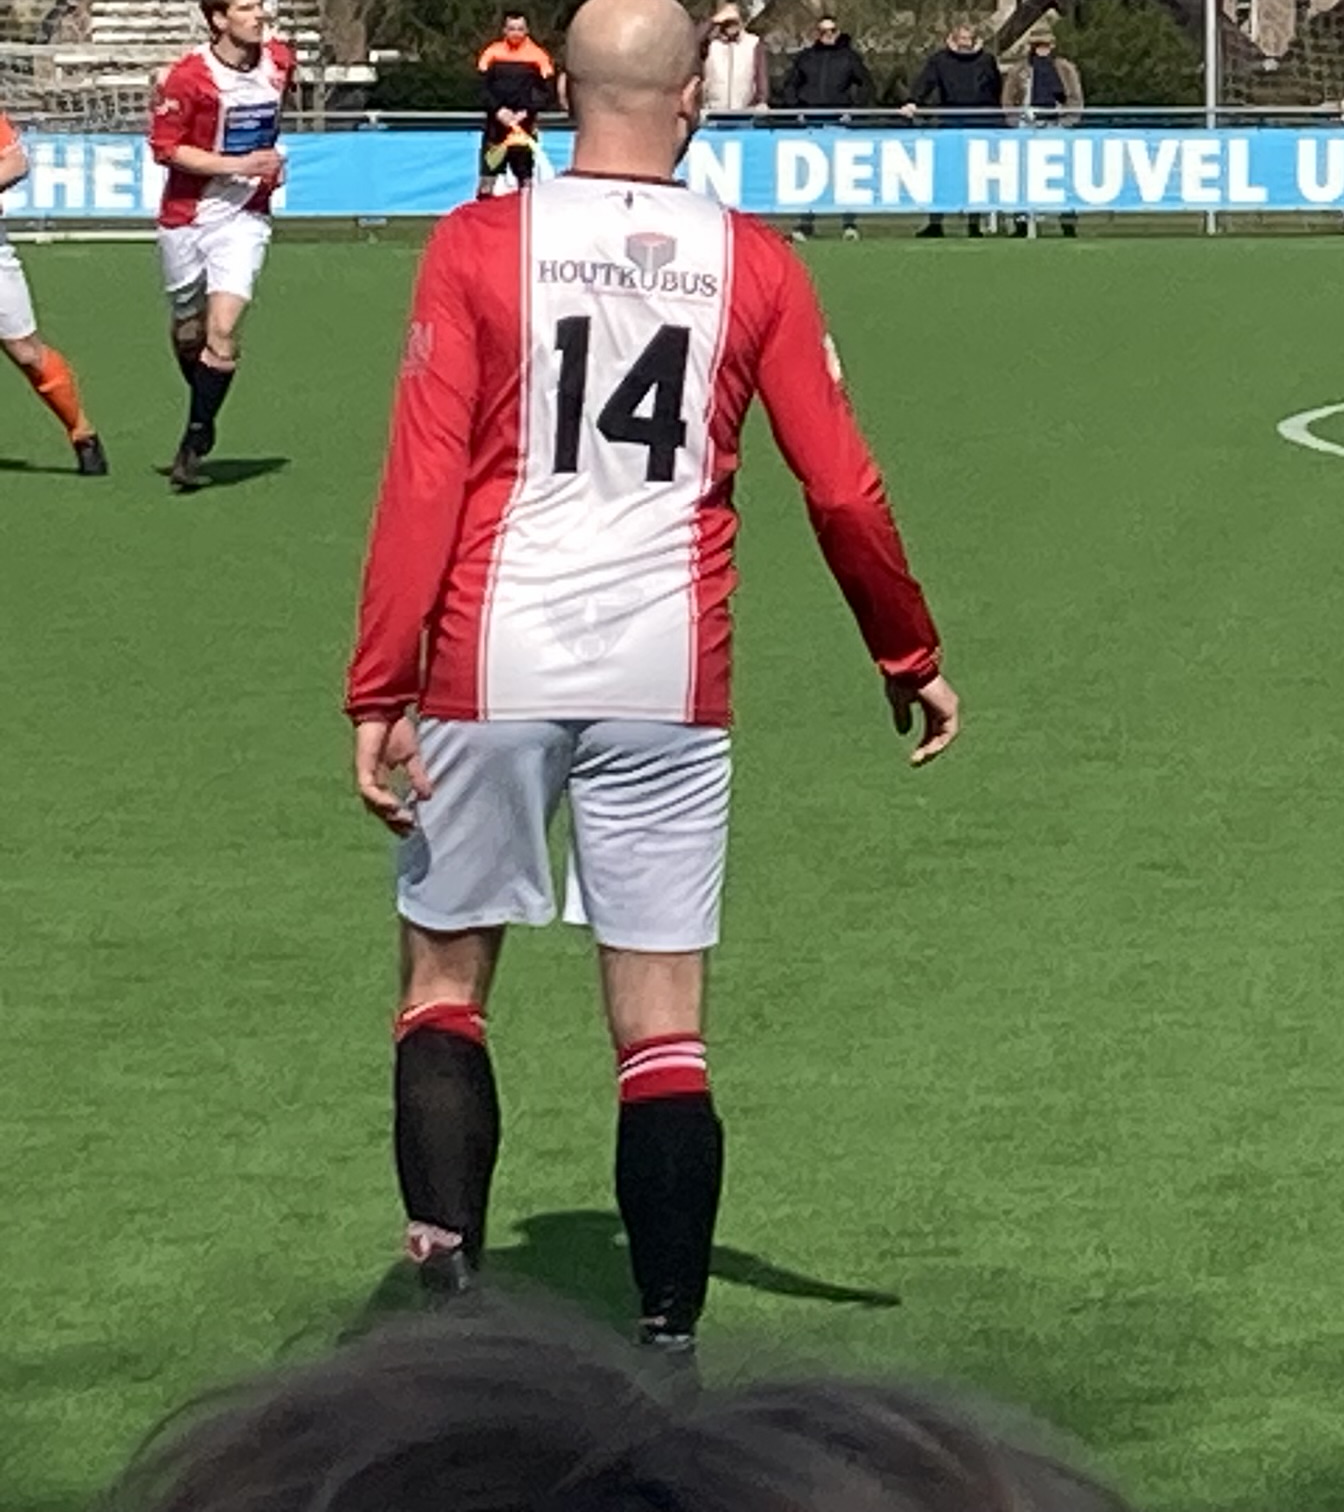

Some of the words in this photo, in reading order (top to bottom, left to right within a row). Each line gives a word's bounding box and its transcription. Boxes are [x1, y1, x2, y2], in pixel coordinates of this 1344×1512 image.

[777, 140, 933, 205] DEN
[968, 138, 1268, 204] HEUVEL
[537, 259, 718, 297] HOUTKUBUS
[552, 315, 692, 482] 14
